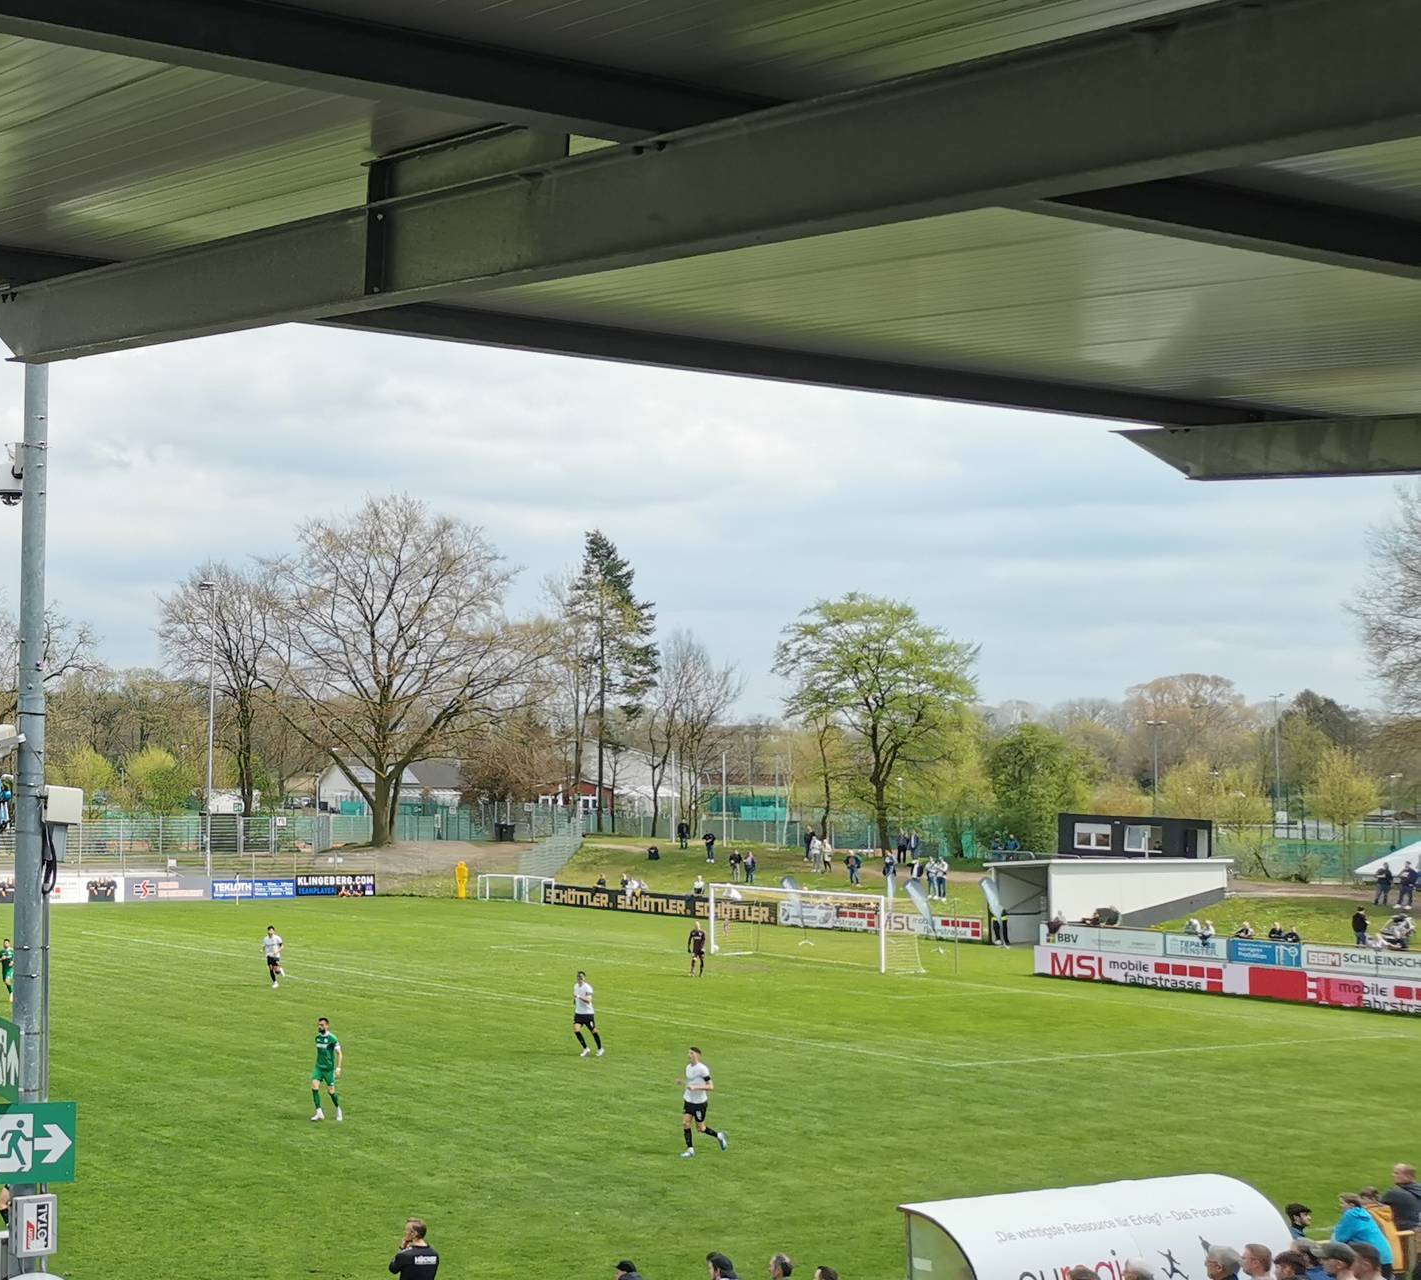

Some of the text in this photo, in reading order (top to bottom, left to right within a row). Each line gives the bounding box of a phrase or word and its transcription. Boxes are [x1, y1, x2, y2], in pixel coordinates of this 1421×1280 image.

[214, 882, 252, 892] TEKLOTH
[298, 876, 374, 886] KLINGEBERG.COM
[546, 886, 613, 909] SCHÖTTLER.
[1057, 933, 1078, 944] BBV
[1050, 952, 1150, 982] MSL mobile
[1124, 974, 1202, 990] fahrstrasse
[1338, 982, 1388, 996] mobile
[38, 1204, 48, 1247] OTAL
[1064, 1220, 1116, 1232] Ressource
[1170, 1210, 1193, 1221] Das
